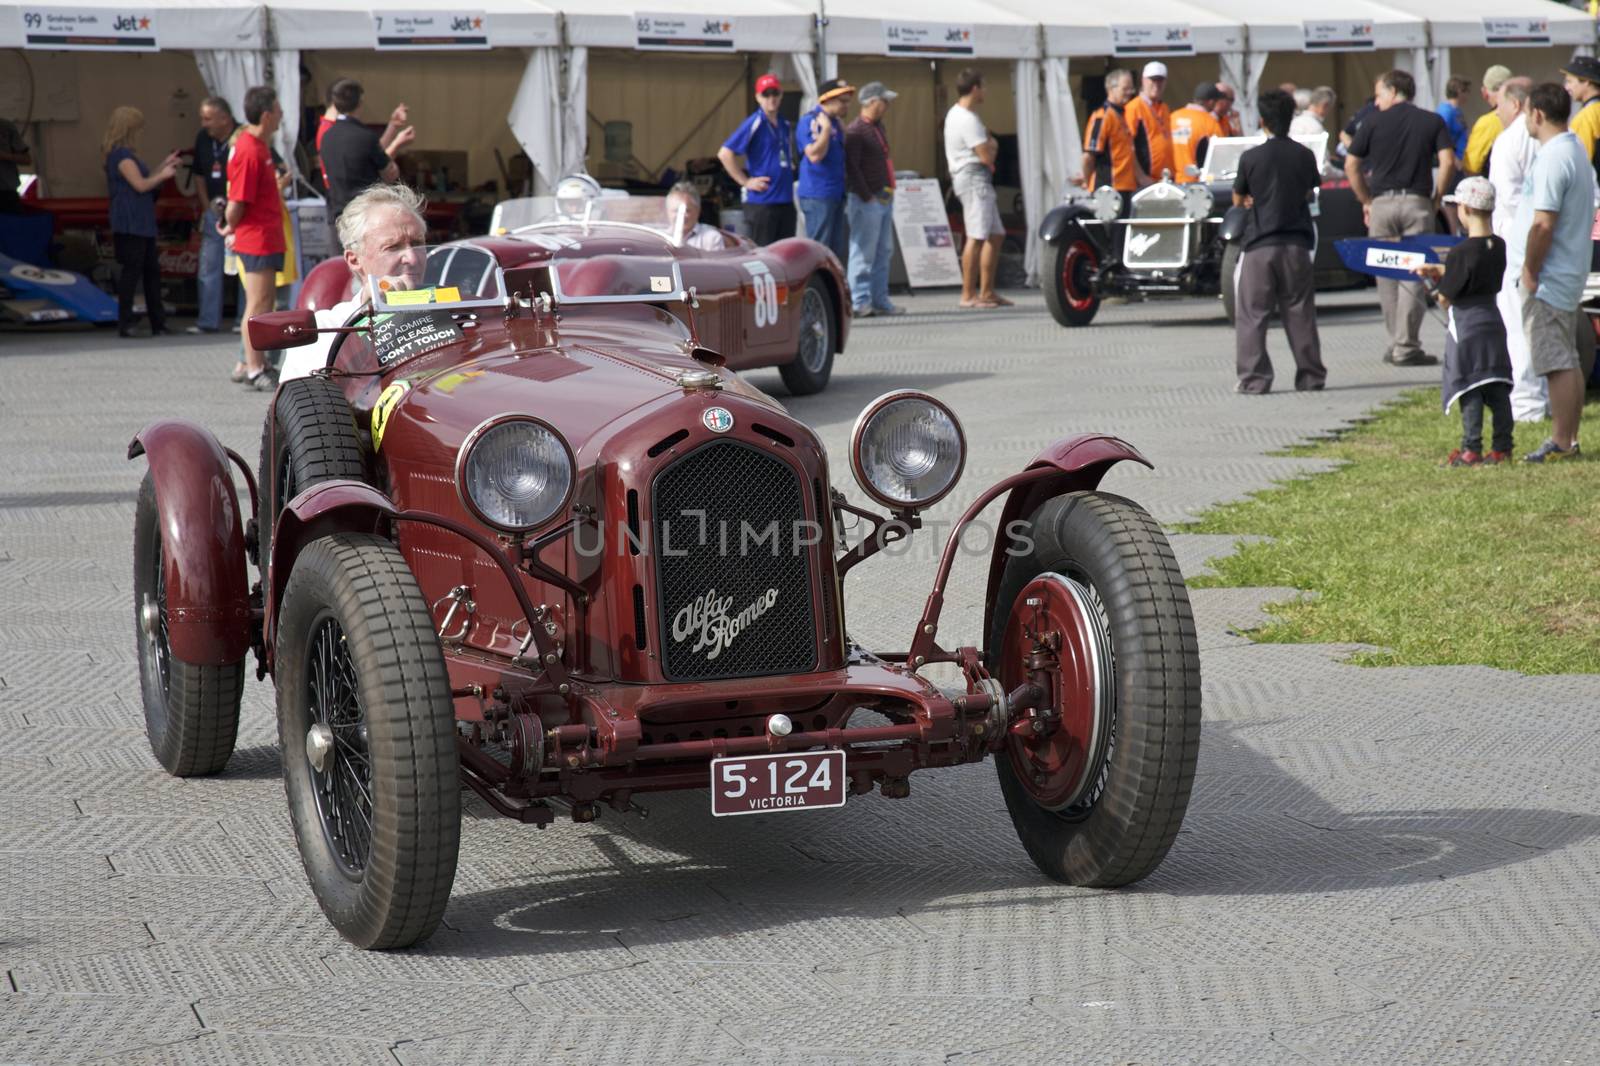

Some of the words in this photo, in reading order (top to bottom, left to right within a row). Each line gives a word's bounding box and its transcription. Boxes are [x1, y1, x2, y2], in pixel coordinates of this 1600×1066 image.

[24, 12, 42, 29] 99
[112, 15, 138, 31] Jet
[450, 16, 472, 31] Jet
[703, 20, 721, 34] Jet
[1376, 252, 1400, 265] Jet
[753, 273, 778, 328] 80
[394, 314, 434, 336] ADMIRE
[375, 341, 396, 356] BUT
[397, 324, 437, 344] PLEASE
[380, 342, 413, 364] DON'T
[414, 328, 456, 347] TOUCH
[672, 588, 734, 653] Alfa
[704, 588, 779, 660] Romeo
[749, 795, 806, 809] VICTORIA
